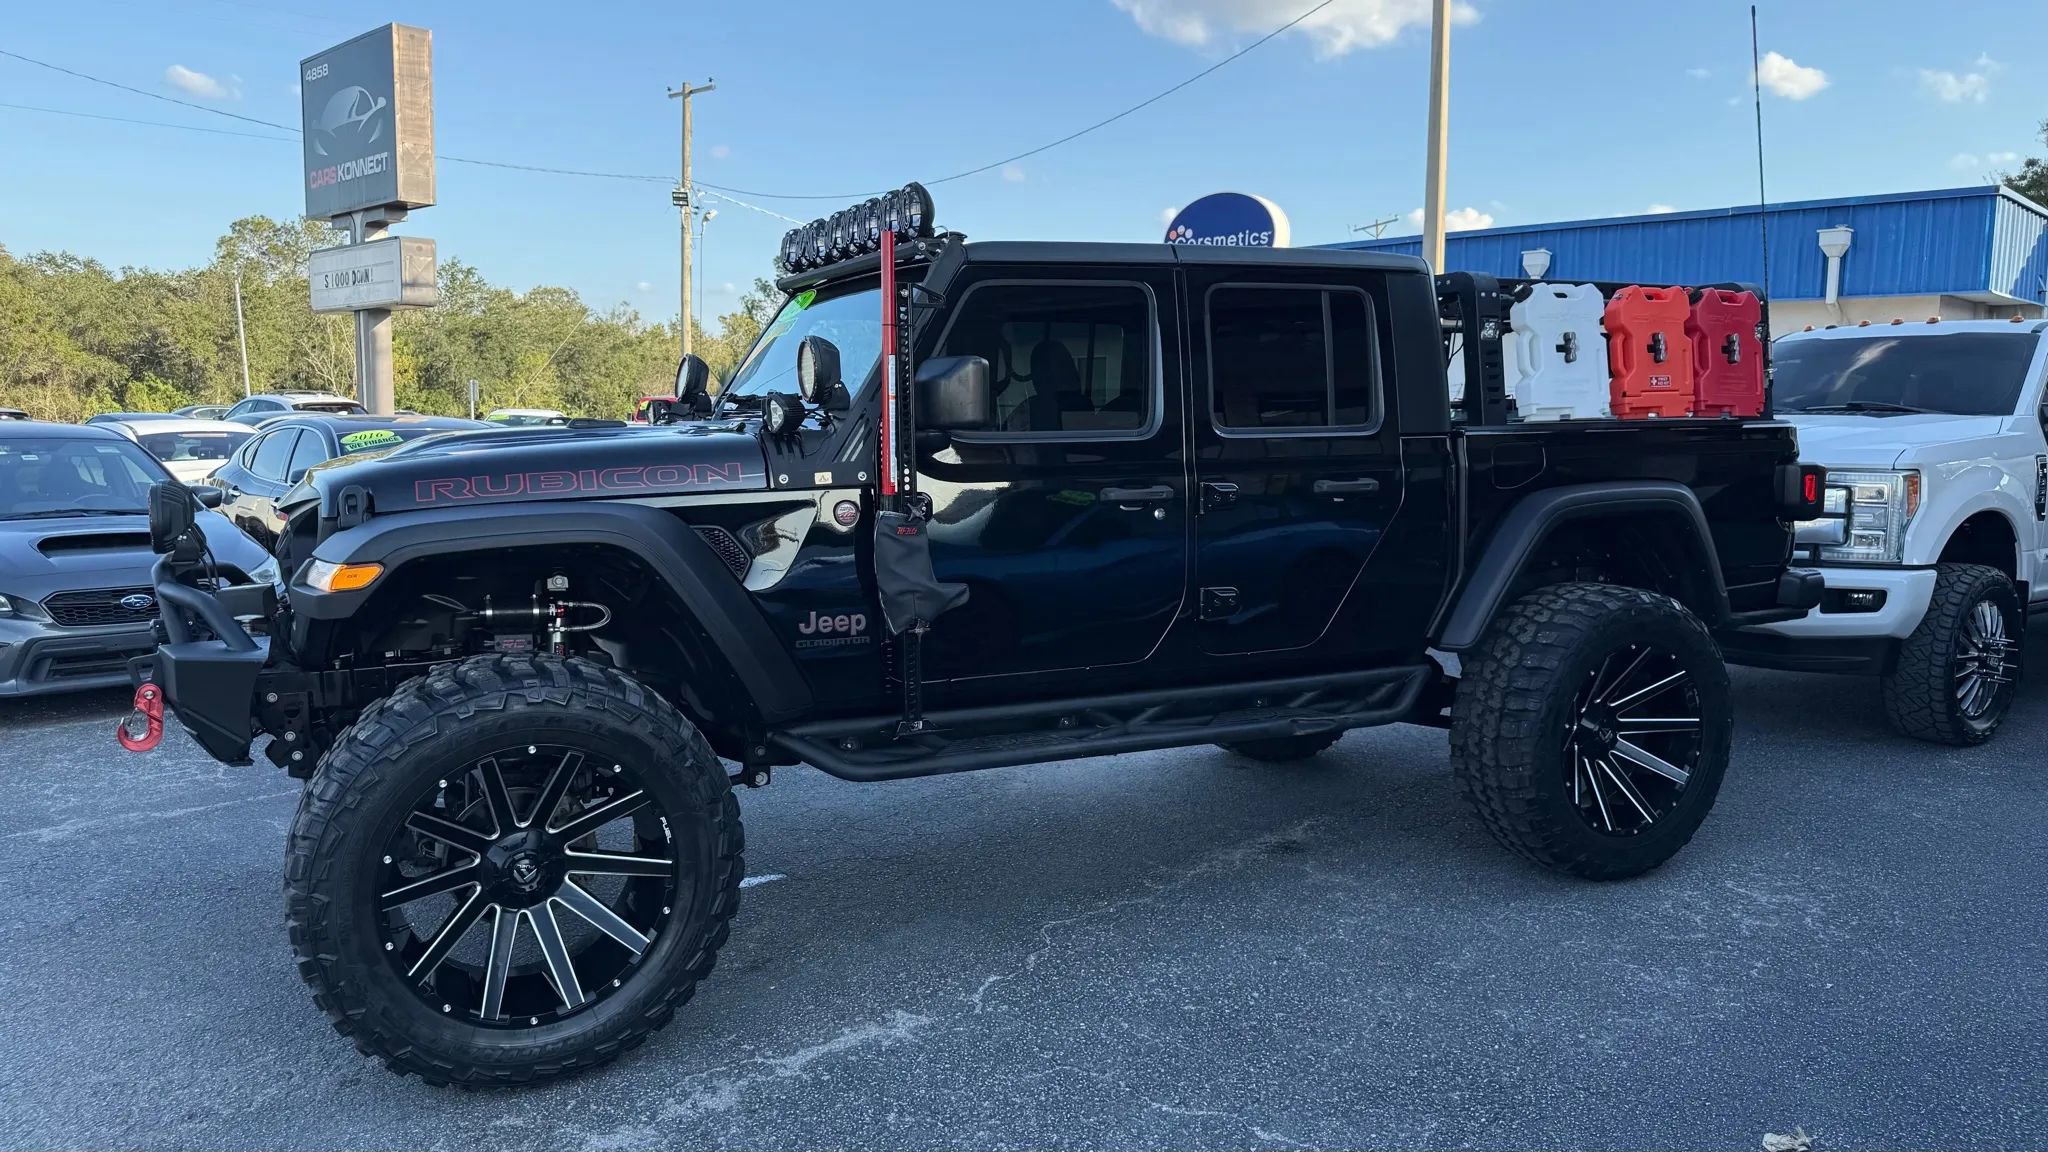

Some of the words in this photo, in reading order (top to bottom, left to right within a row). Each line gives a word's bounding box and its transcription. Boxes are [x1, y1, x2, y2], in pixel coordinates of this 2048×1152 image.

[305, 63, 328, 81] 4858
[351, 432, 383, 443] 2016
[349, 442, 363, 450] WE
[415, 462, 742, 502] RUBICON
[799, 611, 866, 636] Jeep
[795, 636, 871, 648] GLADIATOR
